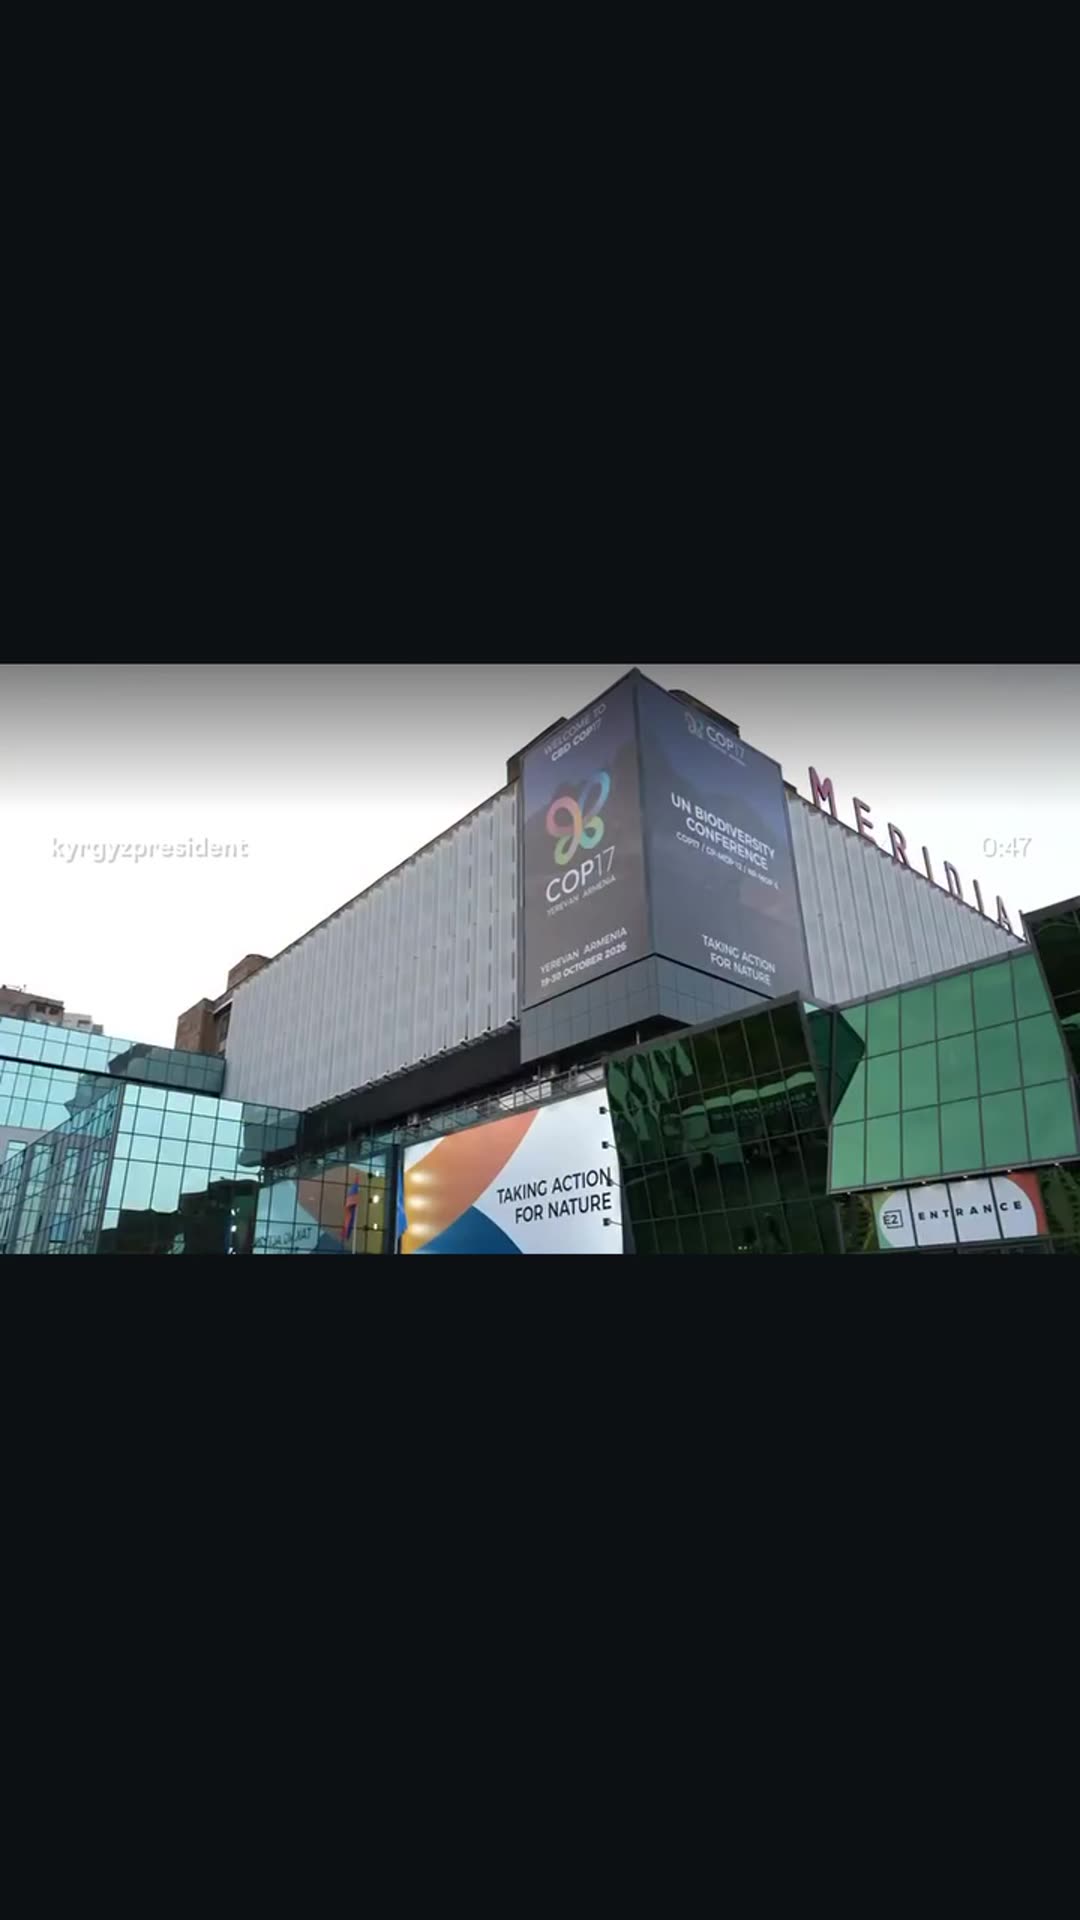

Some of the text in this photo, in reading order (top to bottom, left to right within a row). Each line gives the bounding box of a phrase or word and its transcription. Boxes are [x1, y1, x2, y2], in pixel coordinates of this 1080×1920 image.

[593, 703, 607, 719] TO
[706, 726, 745, 759] COP17
[671, 792, 775, 859] UN BIODIVERSITY
[686, 817, 768, 870] CONFERENCE
[808, 766, 1028, 942] MERIDIA
[546, 846, 615, 902] COP17
[547, 875, 616, 916] YEREVAN ARMENIA
[540, 927, 627, 974] YEREVAN ARMENIA
[563, 953, 603, 978] OCTOBER
[604, 941, 628, 960] 2026
[702, 934, 776, 973] TAKING ACTION
[710, 953, 771, 986] FOR NATURE
[497, 1167, 611, 1204] TAKING ACTION
[515, 1192, 612, 1224] FOR NATURE
[883, 1200, 1022, 1225] E2 ENTRANCE
